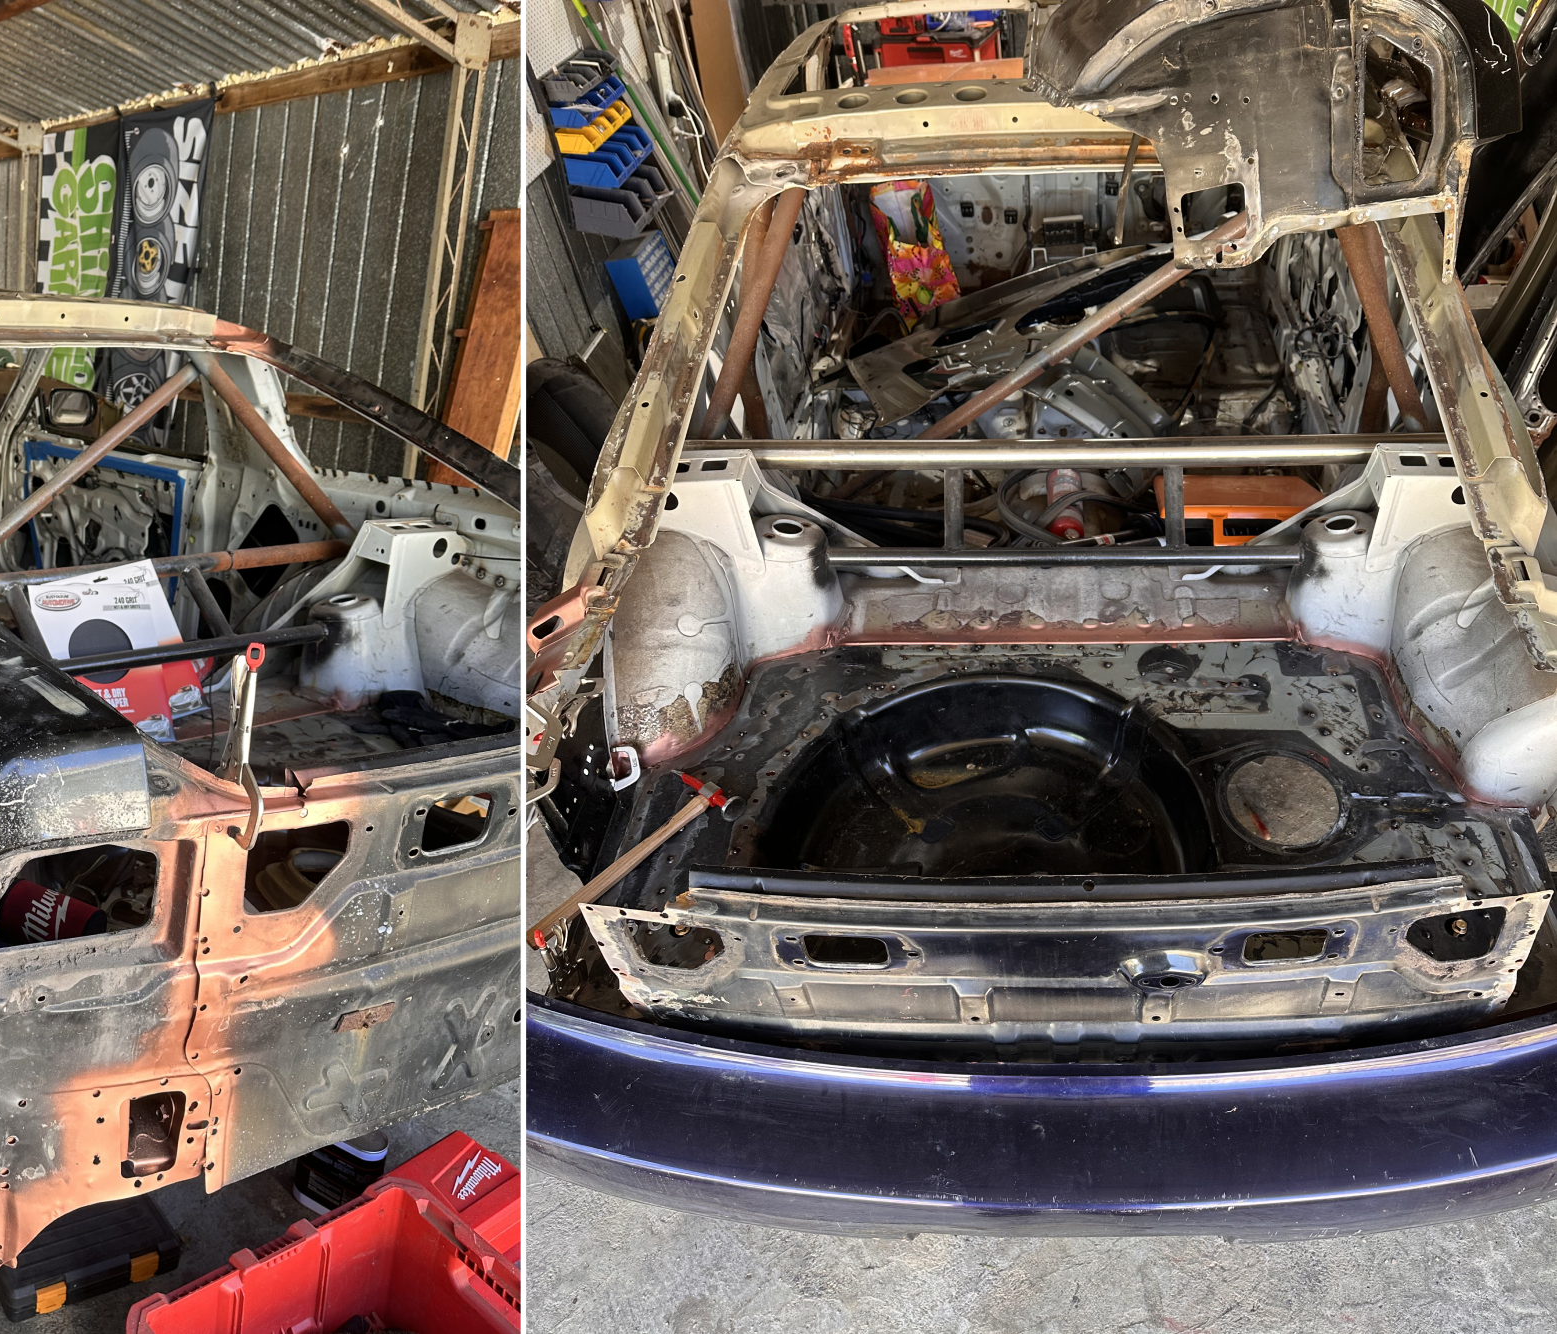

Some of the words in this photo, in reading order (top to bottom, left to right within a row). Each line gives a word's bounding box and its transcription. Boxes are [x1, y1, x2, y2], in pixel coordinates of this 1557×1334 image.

[125, 596, 137, 604] GRIT
[111, 687, 126, 698] DRY
[457, 1156, 502, 1200] Milwaukee
